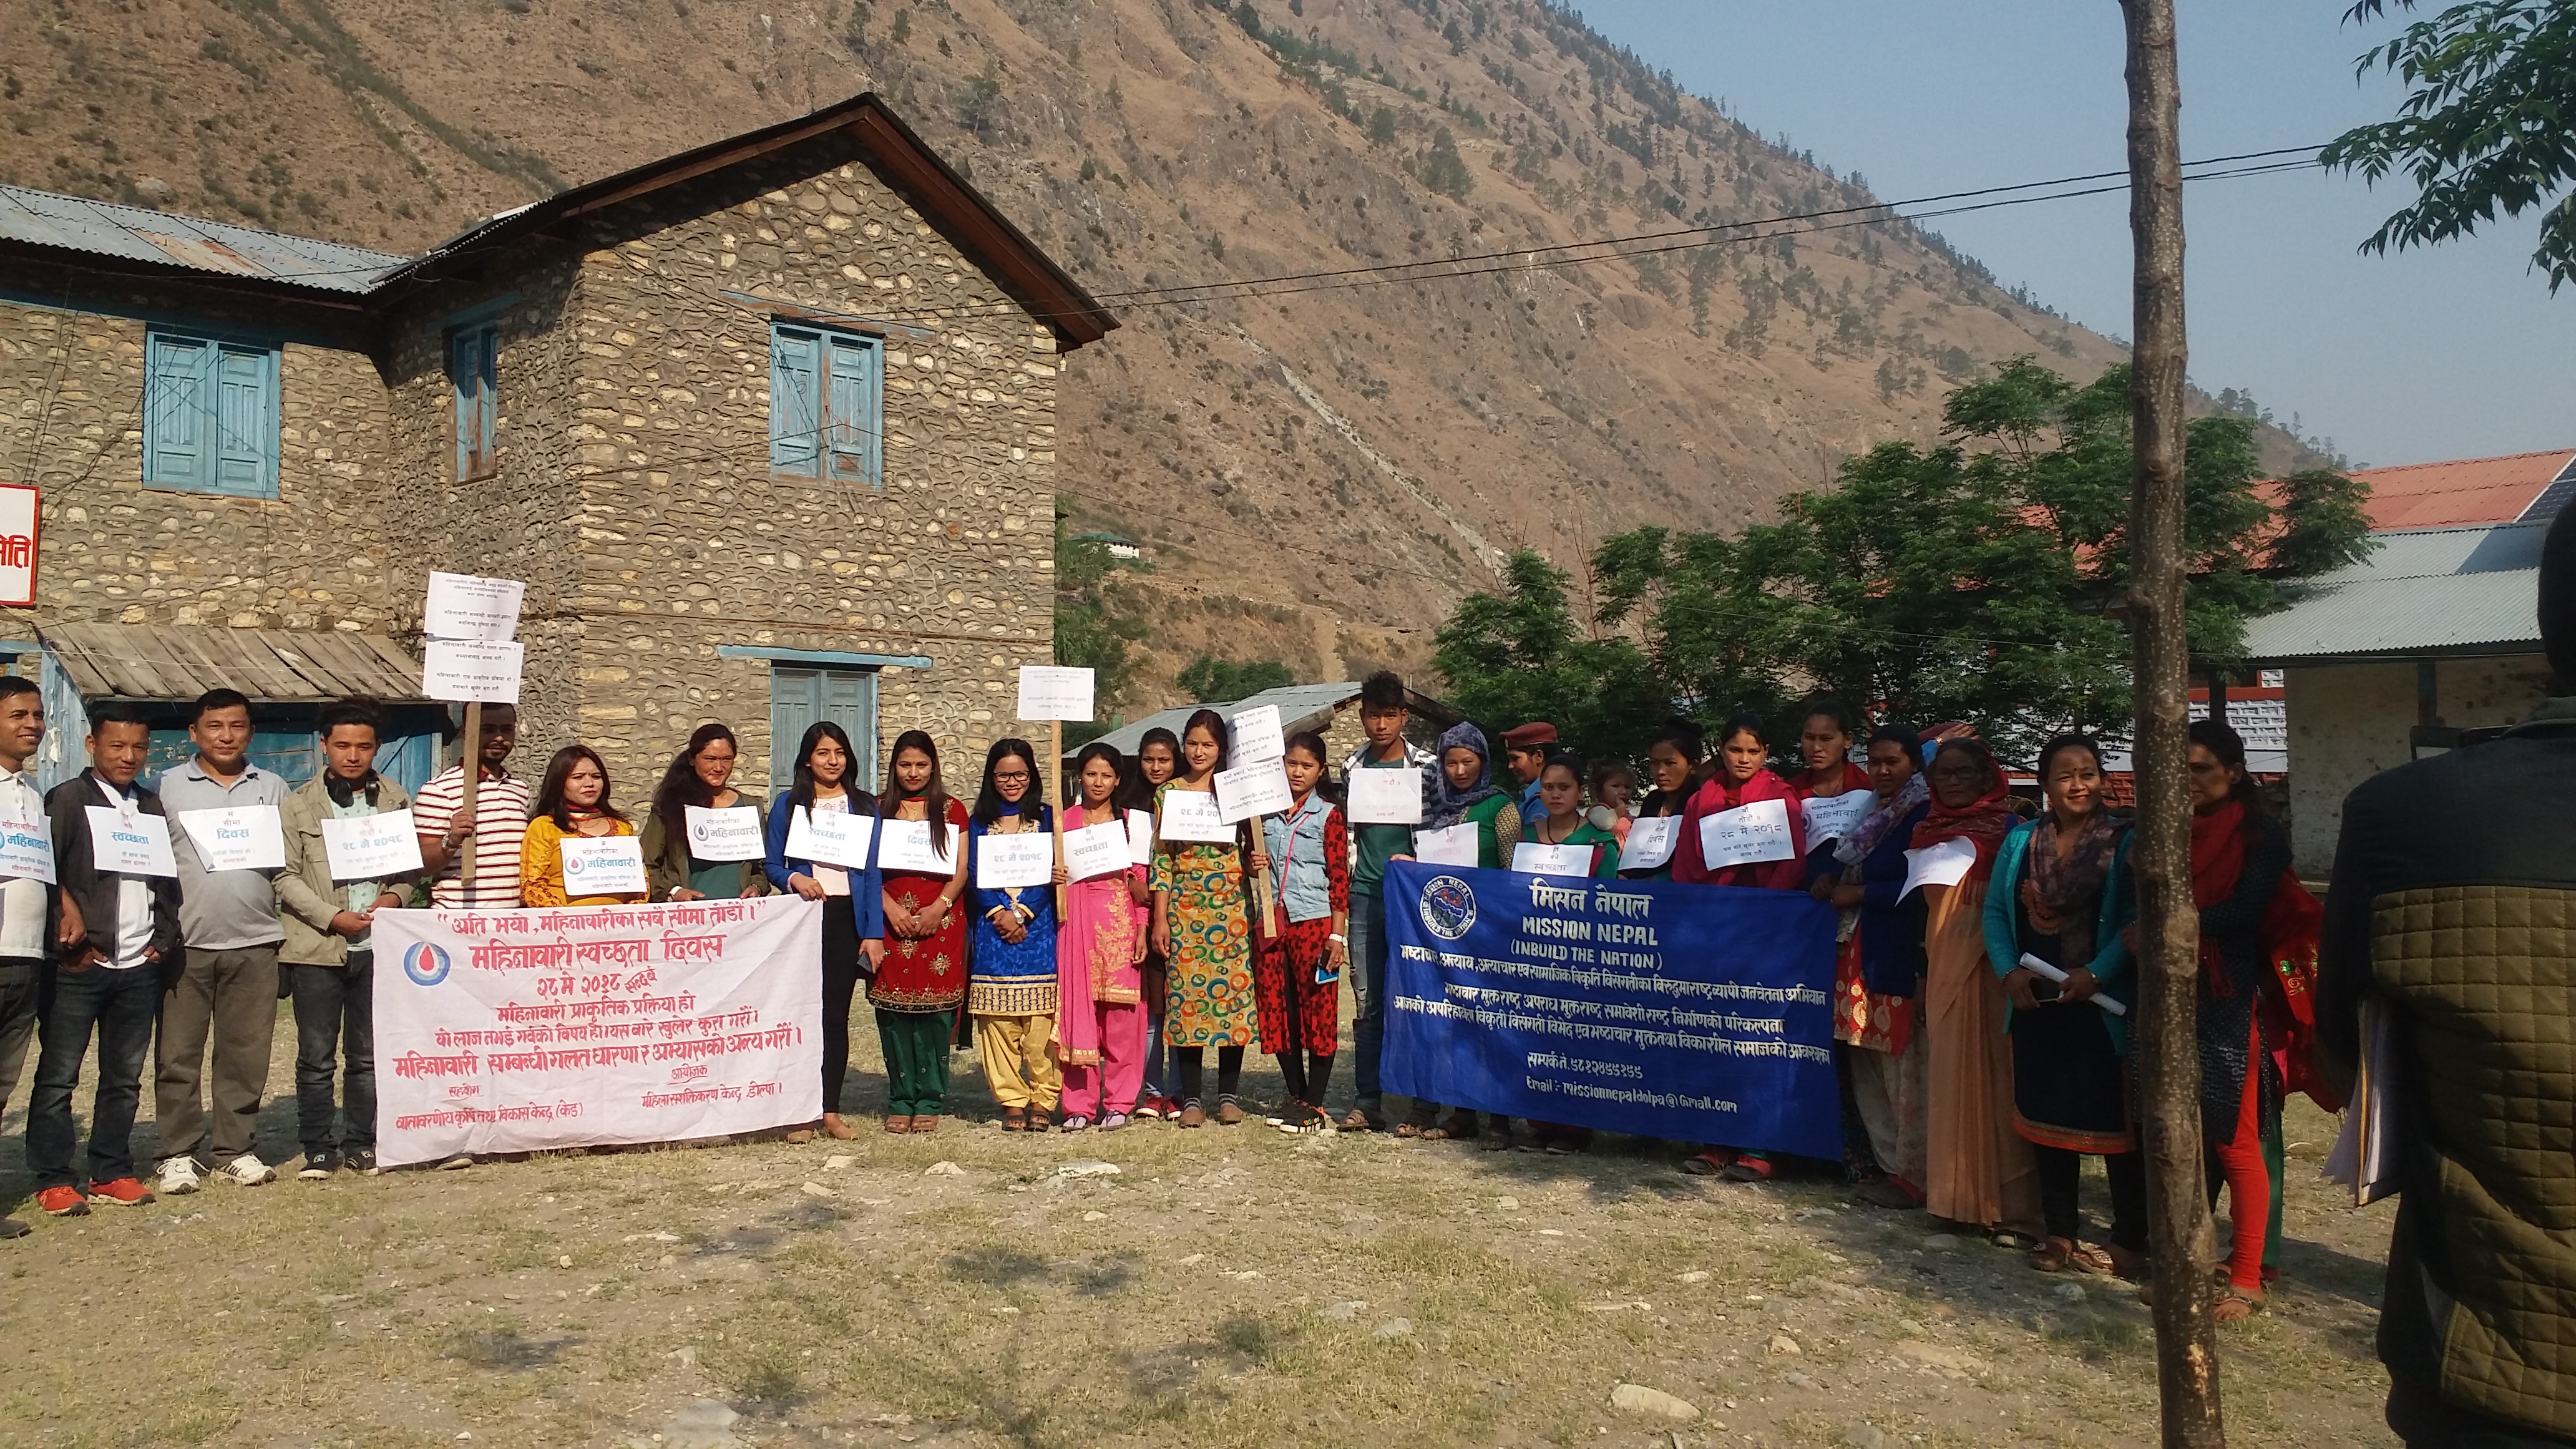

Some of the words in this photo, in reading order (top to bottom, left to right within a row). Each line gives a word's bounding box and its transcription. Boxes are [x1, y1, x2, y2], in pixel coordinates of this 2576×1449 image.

[0, 534, 31, 568] ति
[110, 831, 149, 845] स्वच्छता
[216, 827, 250, 839] दिवस
[373, 834, 403, 847] २०१८
[710, 825, 759, 838] महिनावारी
[809, 827, 846, 841] स्वच्छता
[1720, 831, 1734, 840] २८
[1739, 825, 1748, 836] मे
[1754, 824, 1782, 834] २०१८
[7, 832, 51, 852] महिनावारी
[1073, 841, 1108, 857] स्वच्छता
[587, 857, 637, 869] महिनावारी
[1448, 879, 1470, 899] NEPAL
[1528, 877, 1589, 914] मिसन
[1594, 883, 1654, 920] नेपाल
[492, 912, 530, 934] भयो
[637, 905, 666, 930] सबै
[667, 904, 706, 929] सीमा
[1442, 929, 1454, 937] THE
[1522, 915, 1591, 941] MISSION
[1597, 922, 1659, 947] NEPAL
[468, 935, 574, 977] महिनावारी
[576, 938, 652, 970] स्वच्छता
[659, 929, 728, 965] दिवस
[1510, 938, 1568, 961] (INBUILD
[1571, 947, 1595, 964] THE
[537, 977, 559, 1000] २८
[559, 970, 576, 997] मे
[581, 973, 623, 998] २०१८
[1530, 962, 1571, 983] सामाजिक
[1571, 965, 1602, 990] विकृति
[1739, 981, 1785, 1004] जनचेतना
[497, 998, 566, 1023] महिनावारी
[568, 995, 630, 1023] प्राकृतिक
[678, 989, 696, 1013] हो
[1523, 993, 1559, 1013] अपराध
[1671, 1006, 1722, 1031] निर्माणको
[435, 1027, 451, 1047] यो
[453, 1030, 482, 1048] लाज
[555, 1022, 588, 1043] विषय
[632, 1017, 655, 1038] बारे
[658, 1014, 693, 1040] खुलेर
[698, 1014, 726, 1037] कुरा
[1393, 994, 1426, 1015] आजको
[1733, 1036, 1789, 1059] समाजको
[392, 1049, 480, 1081] महिनावारी
[487, 1045, 549, 1076] सम्बन्धी
[547, 1048, 591, 1071] गलत
[592, 1045, 640, 1068] धारणा
[640, 1045, 651, 1066] र
[1527, 1050, 1559, 1069] सम्पर्क
[671, 1063, 709, 1080] आयोजक
[448, 1083, 482, 1097] सहयोग
[720, 1083, 743, 1103] केन्द्र
[498, 1104, 530, 1123] विकास
[530, 1101, 554, 1123] केन्द्र
